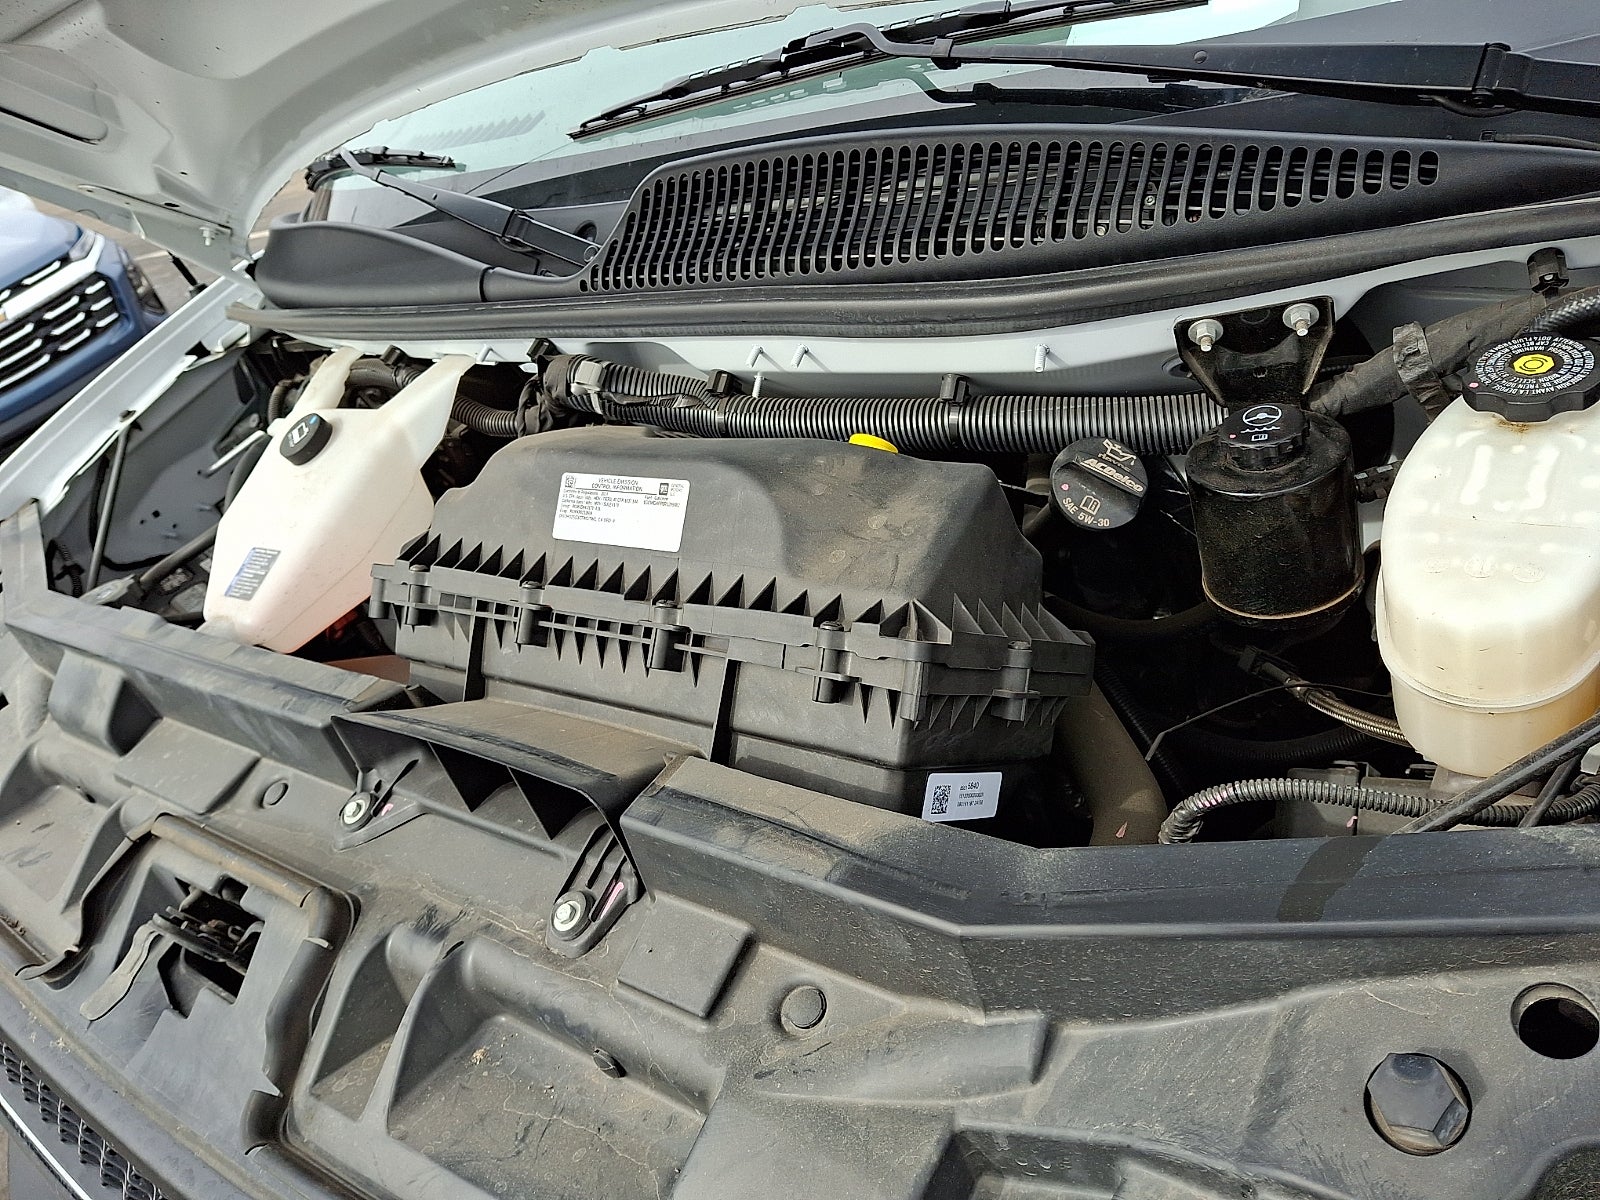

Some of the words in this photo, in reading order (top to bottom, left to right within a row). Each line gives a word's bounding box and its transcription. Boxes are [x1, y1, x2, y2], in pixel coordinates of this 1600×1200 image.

[1080, 458, 1144, 492] ACDelco
[1062, 497, 1078, 514] SAE
[1078, 512, 1110, 526] 5W-30
